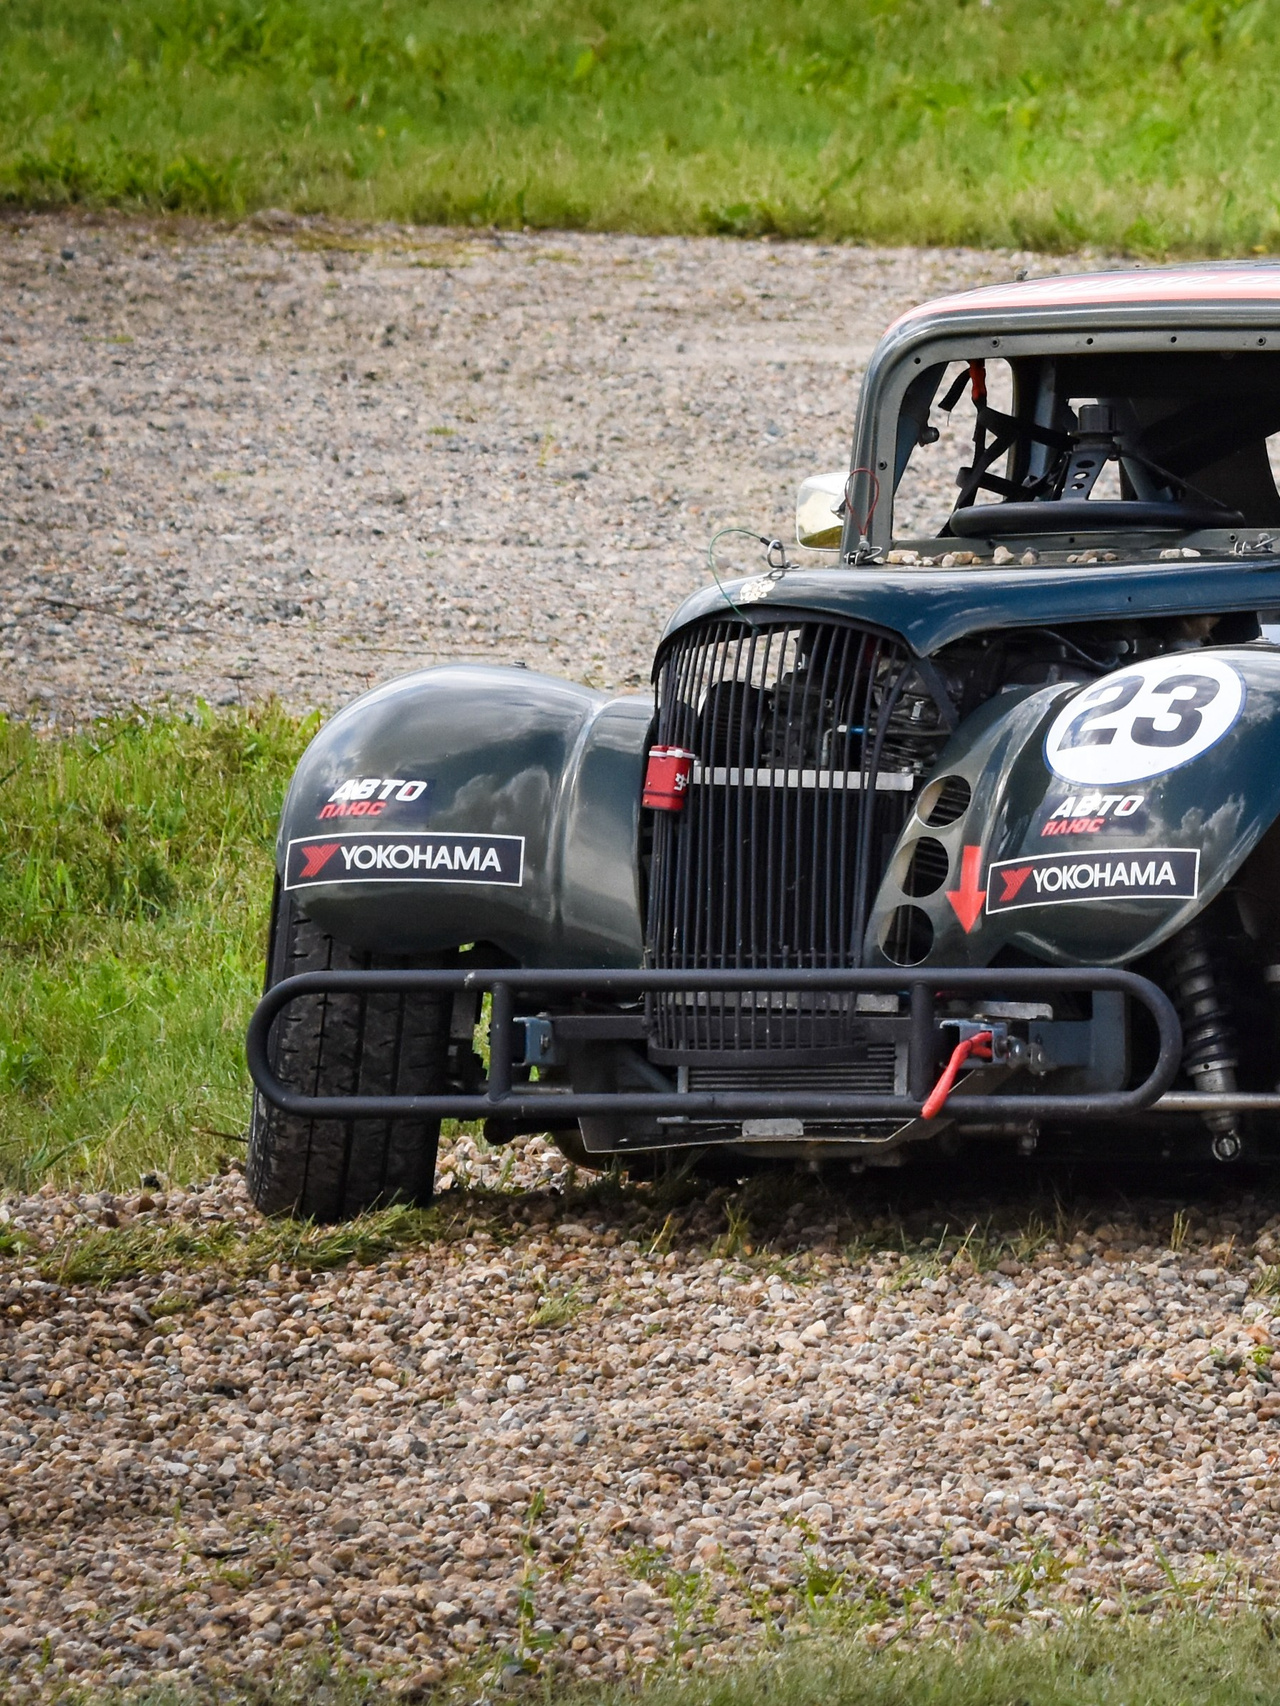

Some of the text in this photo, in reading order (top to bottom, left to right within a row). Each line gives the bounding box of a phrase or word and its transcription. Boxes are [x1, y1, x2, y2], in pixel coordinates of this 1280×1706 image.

[1056, 674, 1221, 752] 23
[327, 778, 428, 802] АВТО
[317, 801, 387, 820] ПЛЮС
[1050, 794, 1145, 820] АВТО
[1041, 818, 1105, 837] ПЛЮС
[340, 845, 502, 873] YOKOHAMA
[1033, 861, 1176, 893] YOKOHAMA
